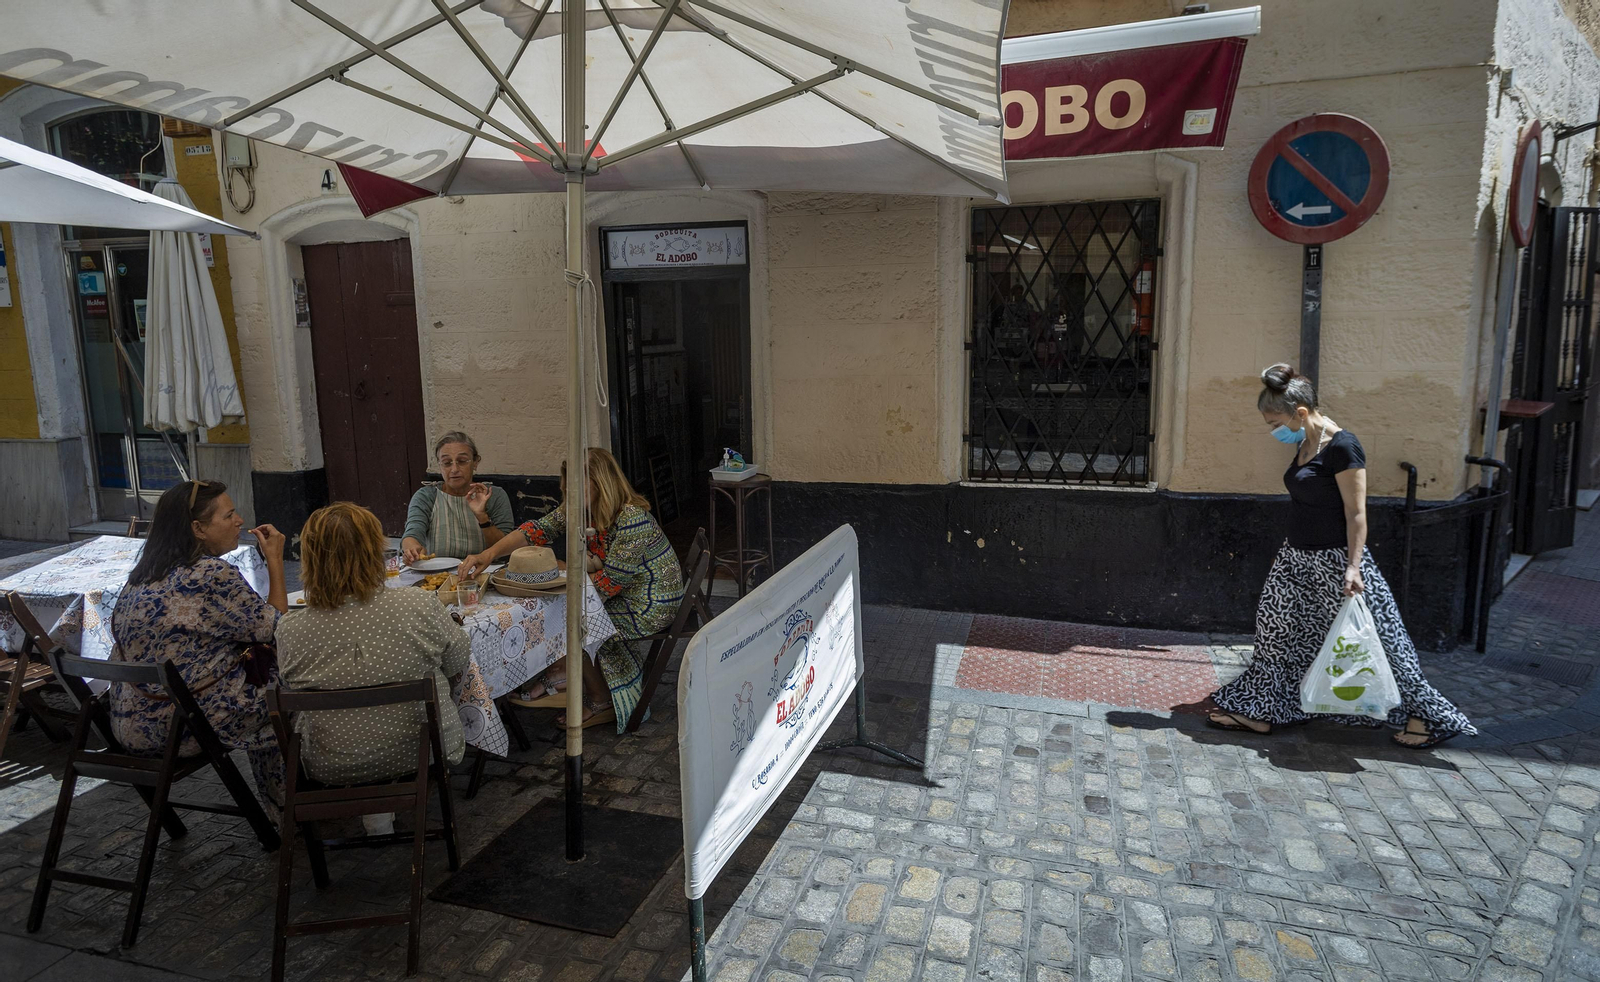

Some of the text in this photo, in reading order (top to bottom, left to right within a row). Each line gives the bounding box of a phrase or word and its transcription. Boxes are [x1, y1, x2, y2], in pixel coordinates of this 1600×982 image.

[654, 229, 698, 240] BODEGUITA
[655, 252, 698, 263] EL ADOBO
[776, 666, 815, 724] EL ADOBO
